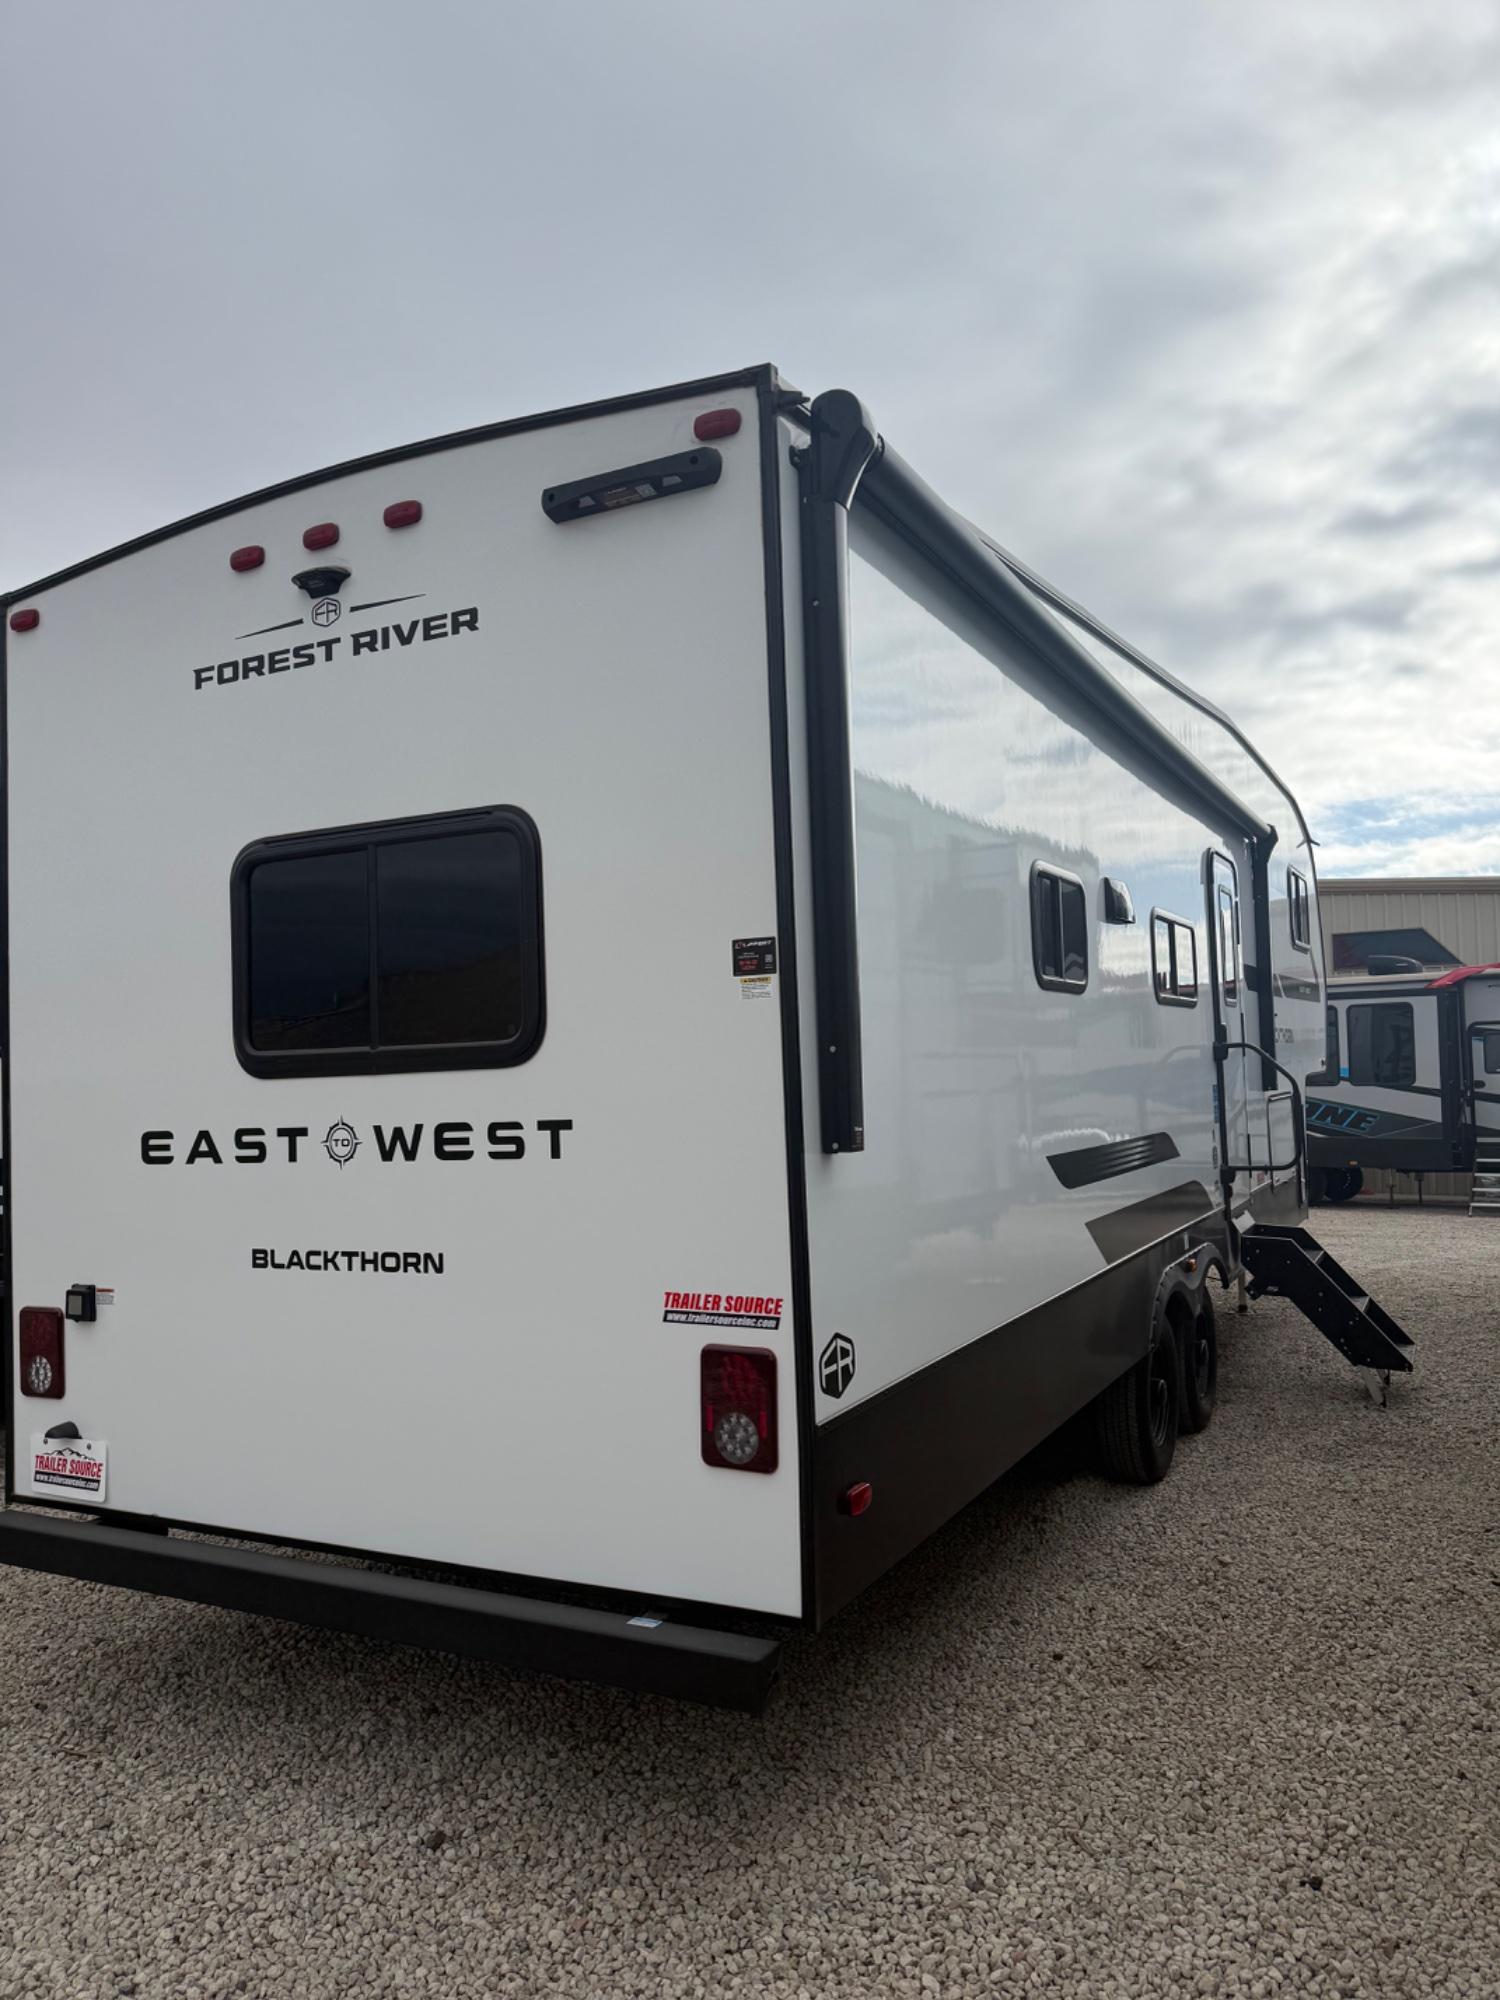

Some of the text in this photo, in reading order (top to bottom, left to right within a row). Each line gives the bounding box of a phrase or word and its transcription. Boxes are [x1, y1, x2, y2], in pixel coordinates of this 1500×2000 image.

[193, 606, 480, 690] FOREST RIVER
[140, 1119, 573, 1165] EAST TO WEST
[251, 1248, 444, 1274] BLACKTHORN
[664, 1291, 784, 1315] TRAILER SOURCE
[666, 1312, 778, 1328] www.trailersourceinc.com
[35, 1455, 103, 1478] TRAILER SOURCE
